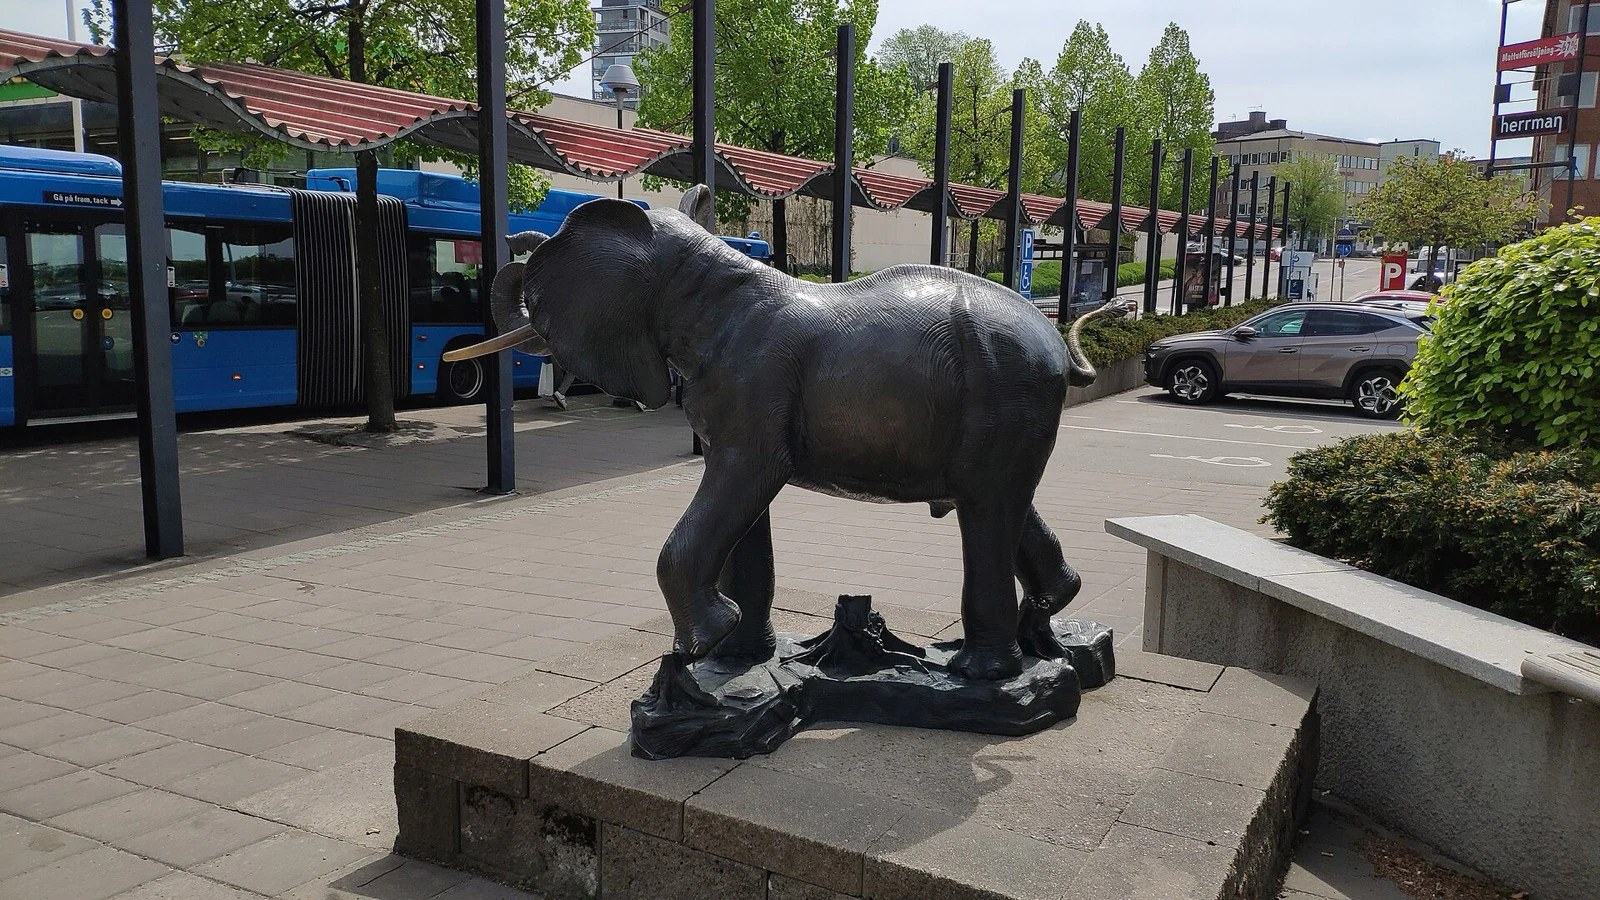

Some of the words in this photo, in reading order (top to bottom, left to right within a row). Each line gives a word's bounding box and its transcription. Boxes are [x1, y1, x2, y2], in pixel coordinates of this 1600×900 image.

[53, 193, 64, 201] Gå
[64, 194, 74, 204] på
[74, 195, 93, 204] fram,
[1025, 233, 1032, 258] P
[1383, 263, 1402, 289] P
